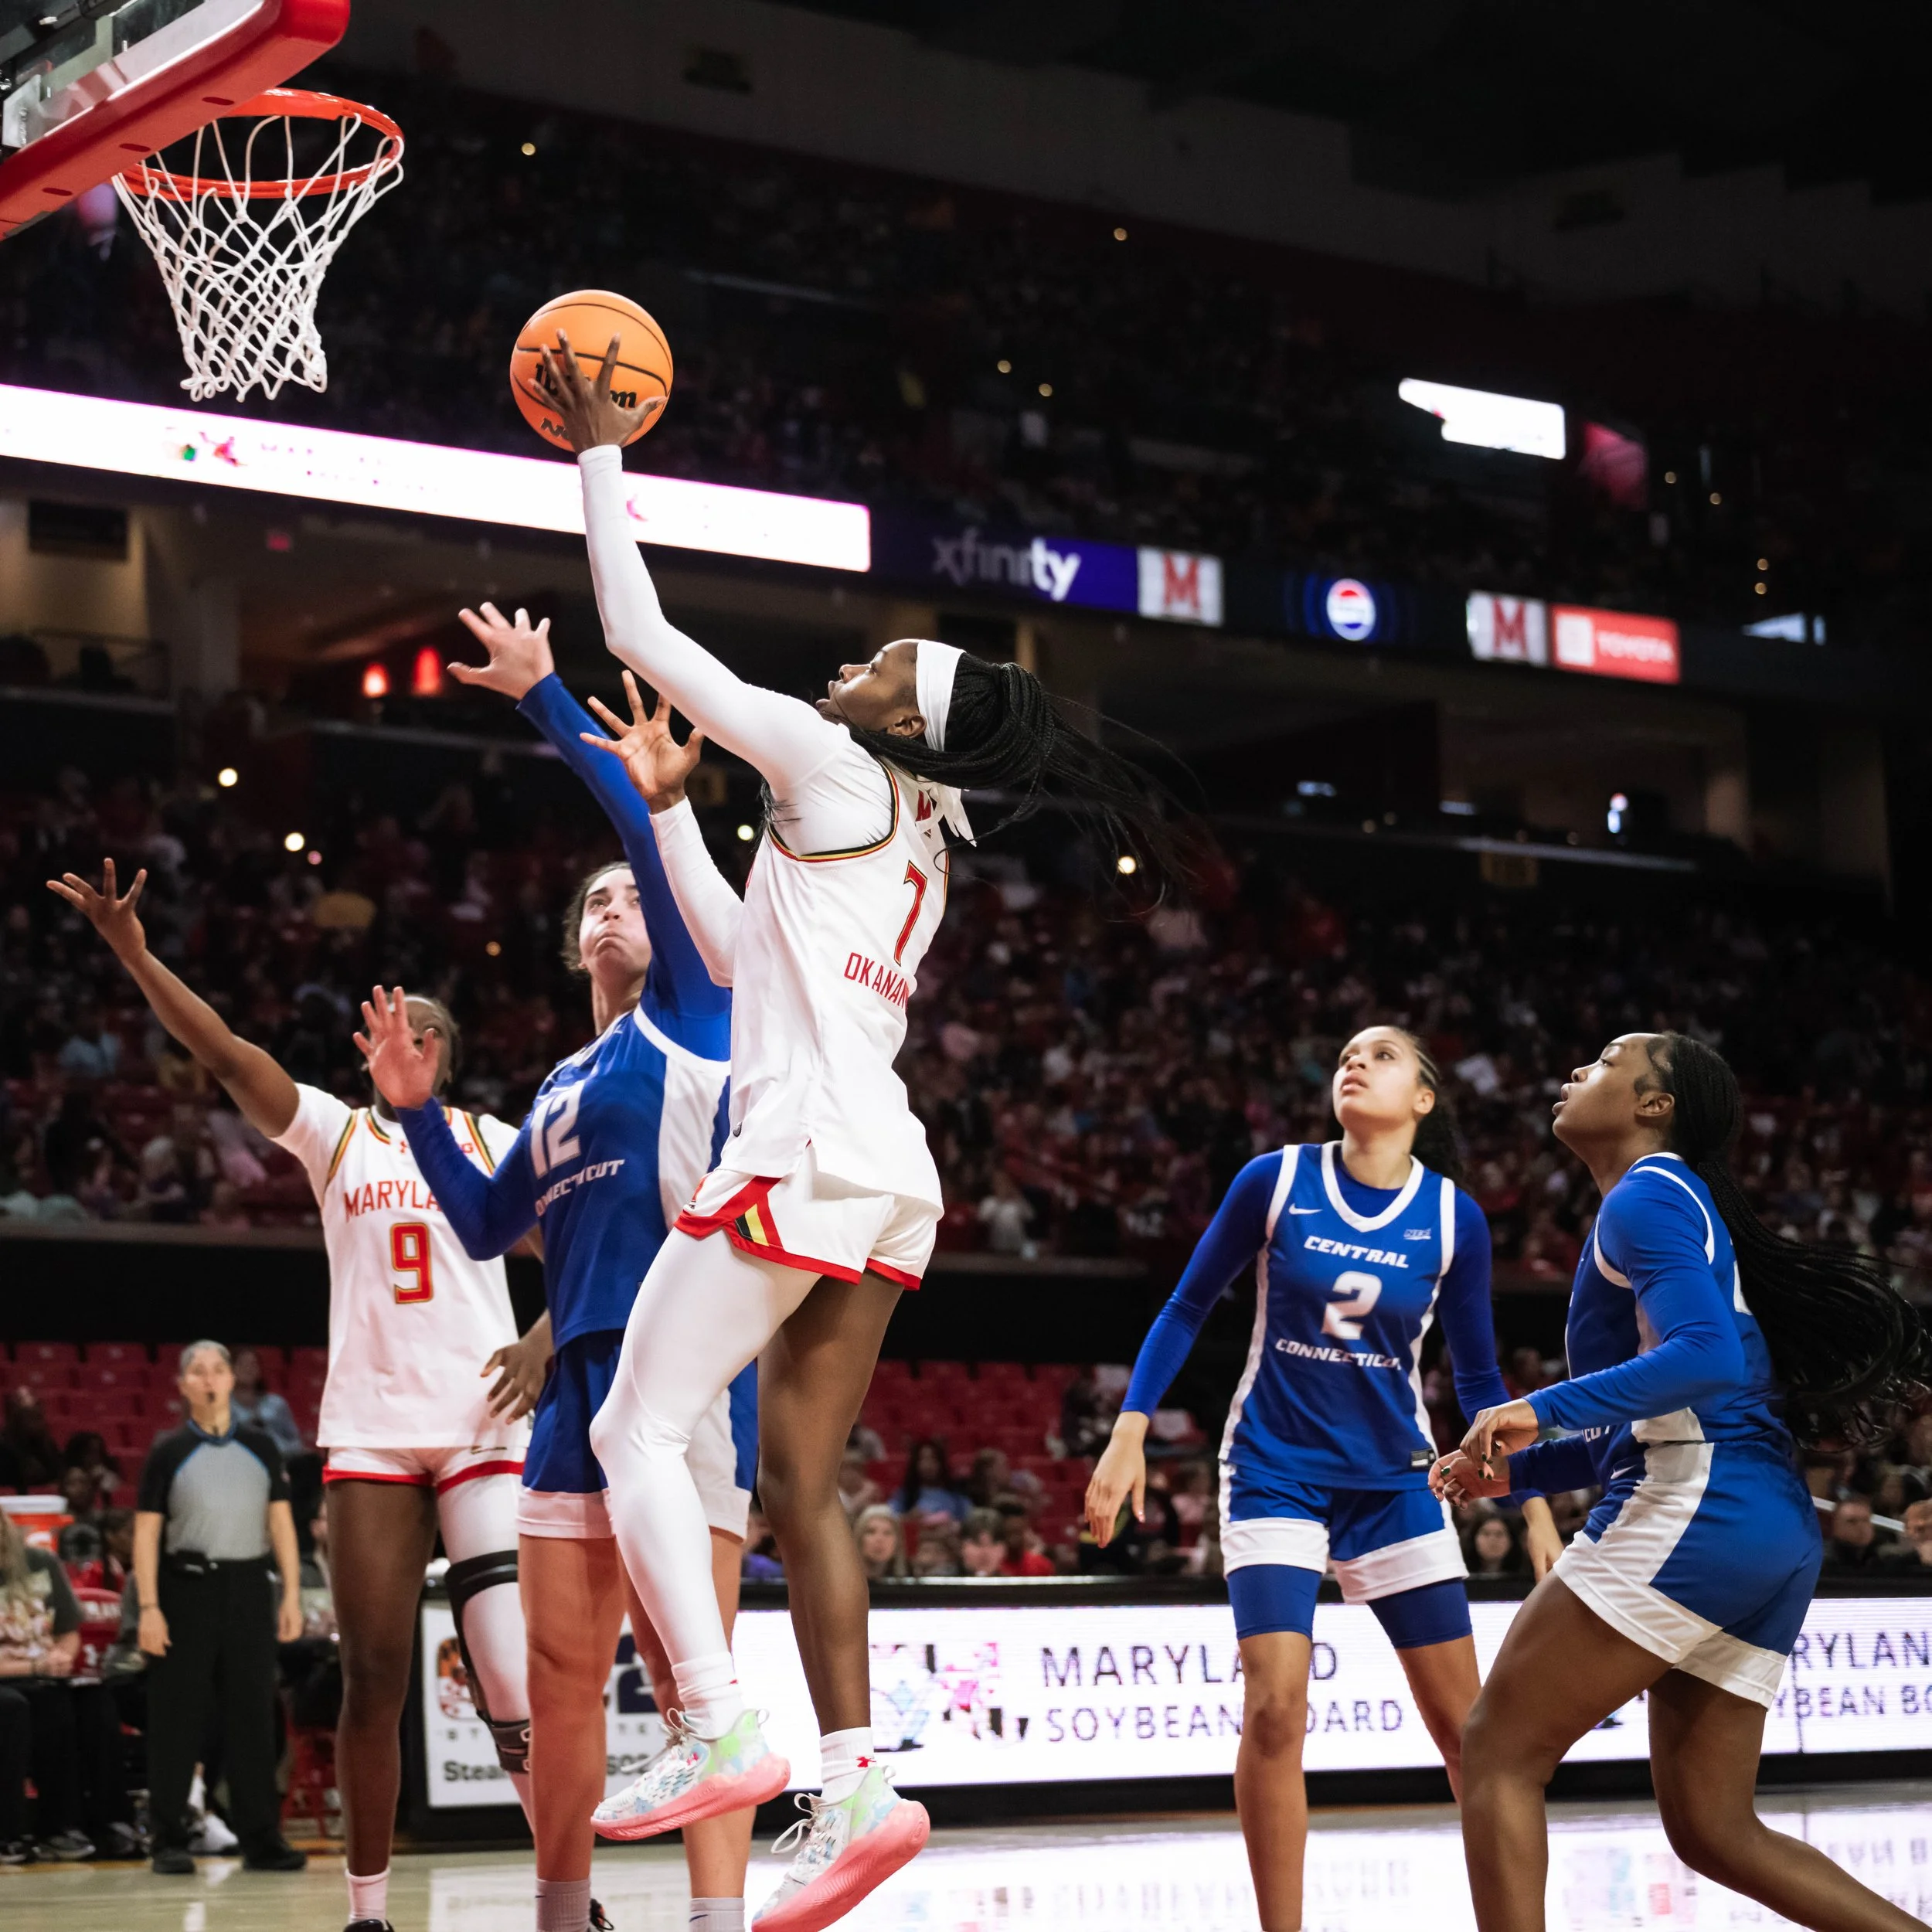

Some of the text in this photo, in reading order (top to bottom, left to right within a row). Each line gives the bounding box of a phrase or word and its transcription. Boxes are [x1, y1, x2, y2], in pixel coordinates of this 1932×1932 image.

[933, 526, 1081, 601] xfinity
[894, 859, 928, 967] 7
[531, 1085, 581, 1179] 12
[390, 1222, 434, 1304] 9
[1304, 1236, 1409, 1268] CENTRAL
[1321, 1270, 1383, 1340] 2
[1046, 1705, 1243, 1743] SOYBEAN
